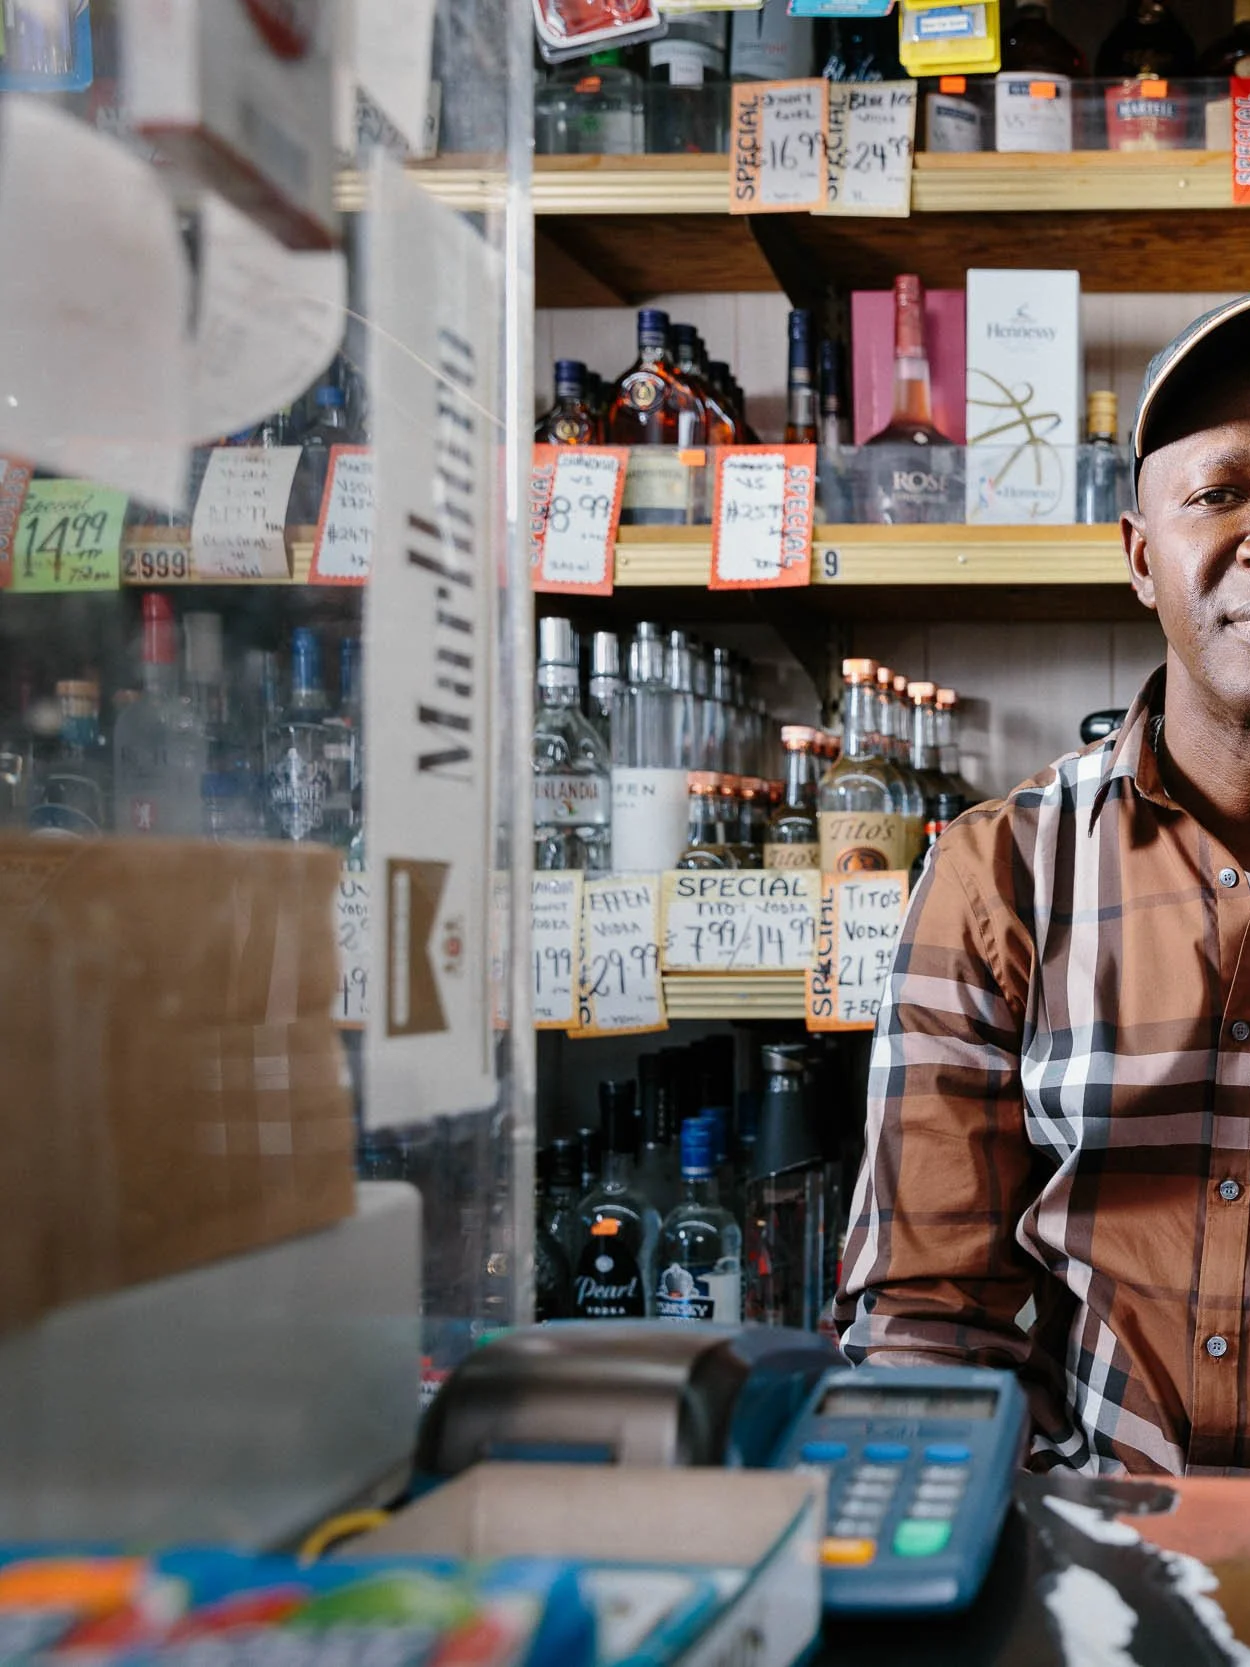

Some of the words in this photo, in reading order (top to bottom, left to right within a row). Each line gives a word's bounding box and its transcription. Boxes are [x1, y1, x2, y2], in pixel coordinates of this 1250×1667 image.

[736, 95, 761, 201] SPECIAL
[985, 322, 1057, 343] Hennessy
[785, 466, 808, 568] SPECIAL
[824, 551, 838, 577] 9
[830, 817, 896, 842] Tito's
[677, 877, 808, 898] SPECIAL
[811, 887, 834, 1017] SPECIAL
[574, 1275, 638, 1305] Pearl
[586, 1305, 626, 1315] VODKA
